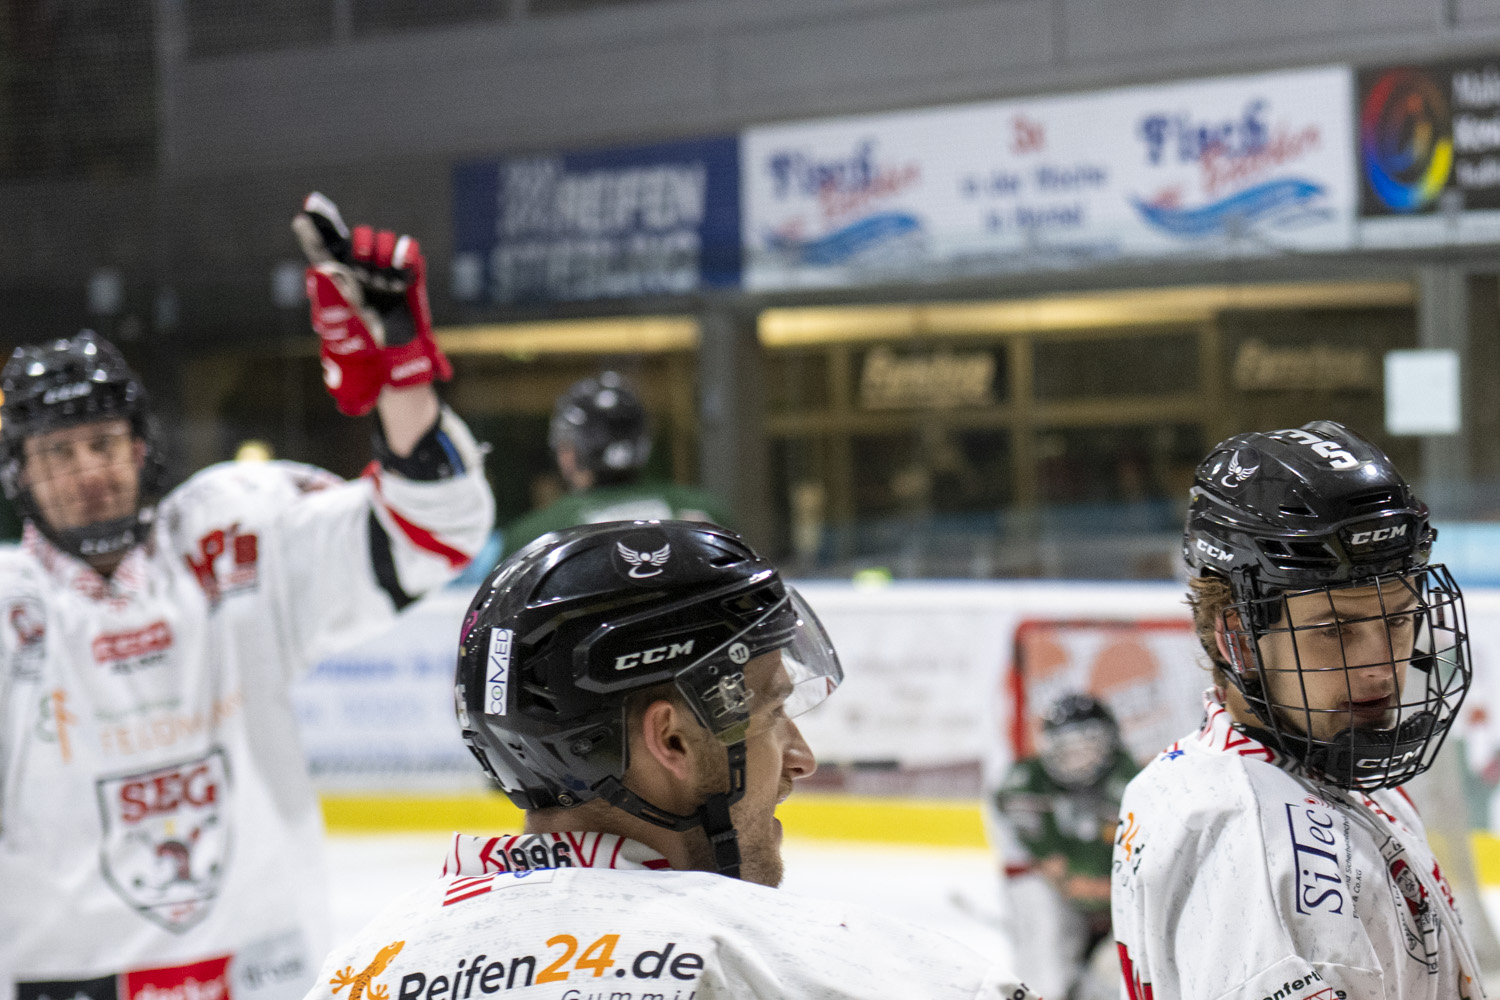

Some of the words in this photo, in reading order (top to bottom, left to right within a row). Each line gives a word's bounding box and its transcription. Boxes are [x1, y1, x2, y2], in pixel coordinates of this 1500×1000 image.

[1196, 538, 1235, 562] CCM
[1351, 523, 1408, 546] CCM
[614, 639, 695, 671] CCM
[1356, 747, 1422, 770] CCM
[118, 764, 219, 825] SEG
[496, 841, 573, 873] 1996
[1286, 803, 1344, 916] SiTec
